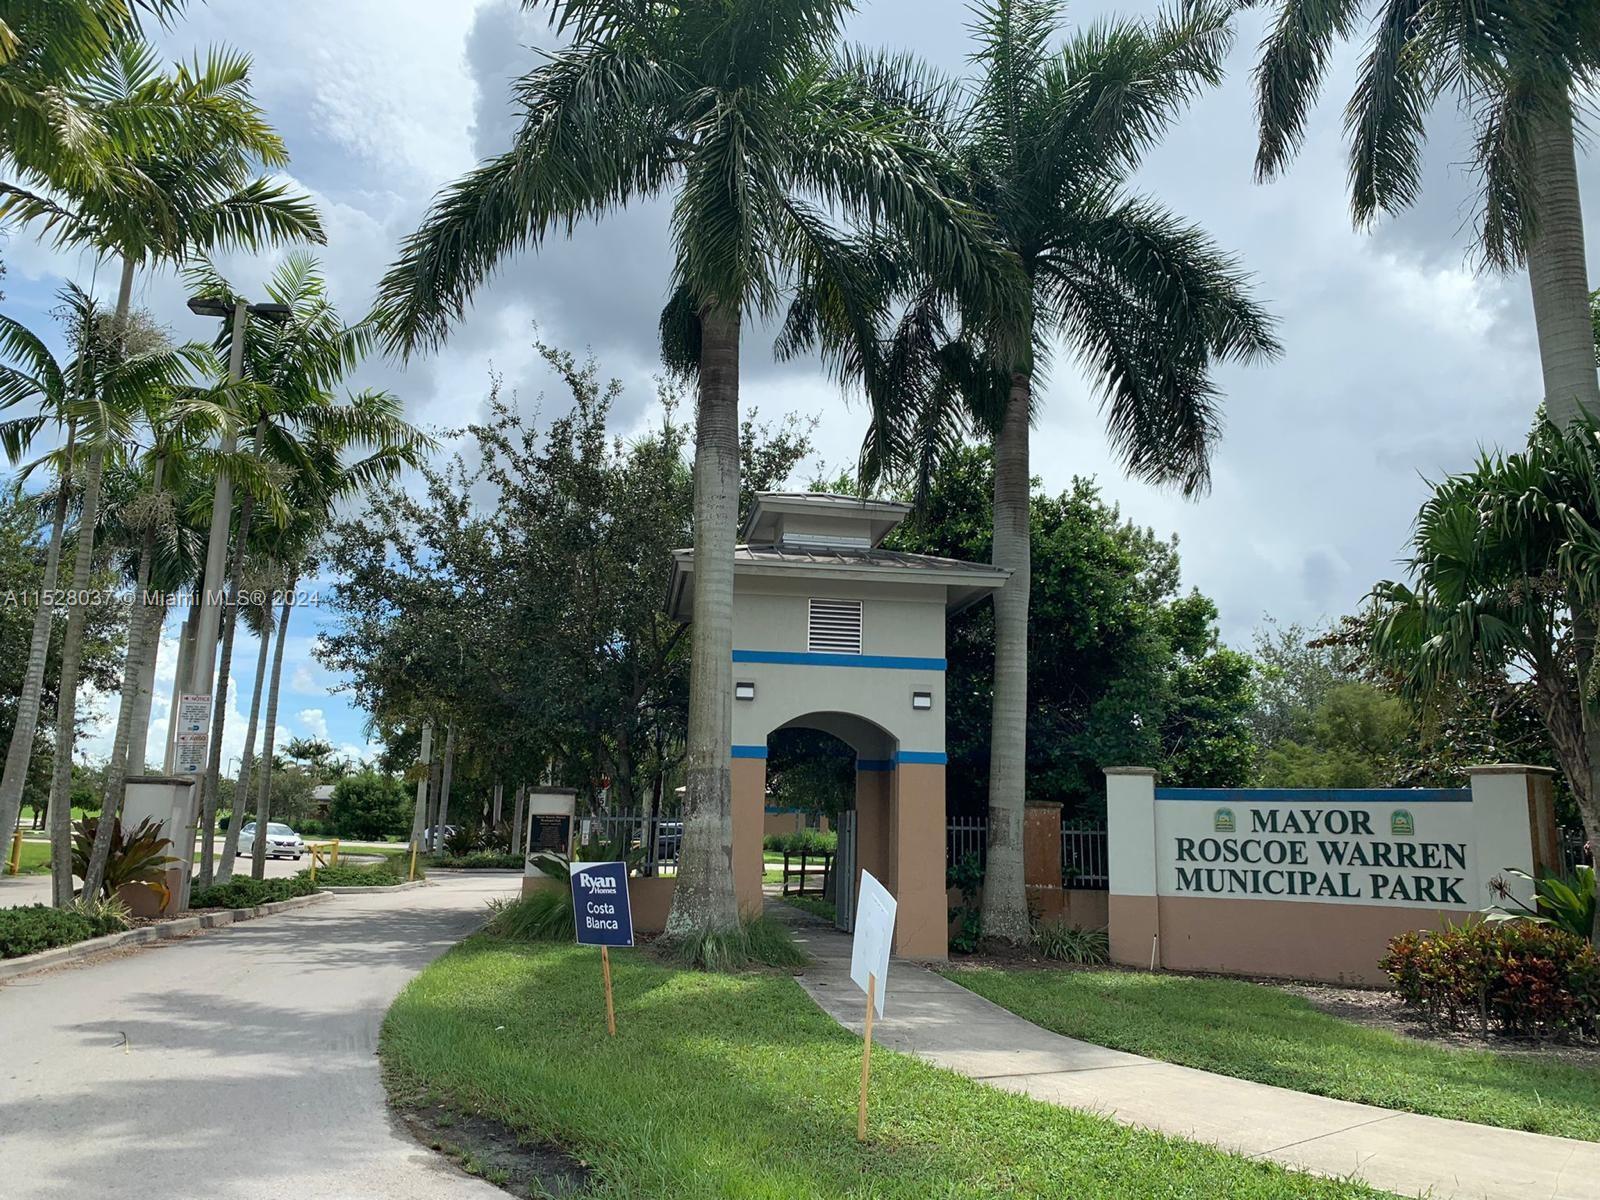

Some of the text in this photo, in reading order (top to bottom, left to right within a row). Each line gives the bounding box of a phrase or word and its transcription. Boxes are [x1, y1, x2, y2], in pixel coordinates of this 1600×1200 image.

[1250, 809, 1374, 835] MAYOR
[1175, 838, 1467, 870] ROSCOE WARREN
[580, 873, 616, 894] Ryan
[1175, 867, 1467, 904] MUNICIPAL PARK
[587, 901, 614, 914] Costa
[586, 916, 618, 929] Blanca
